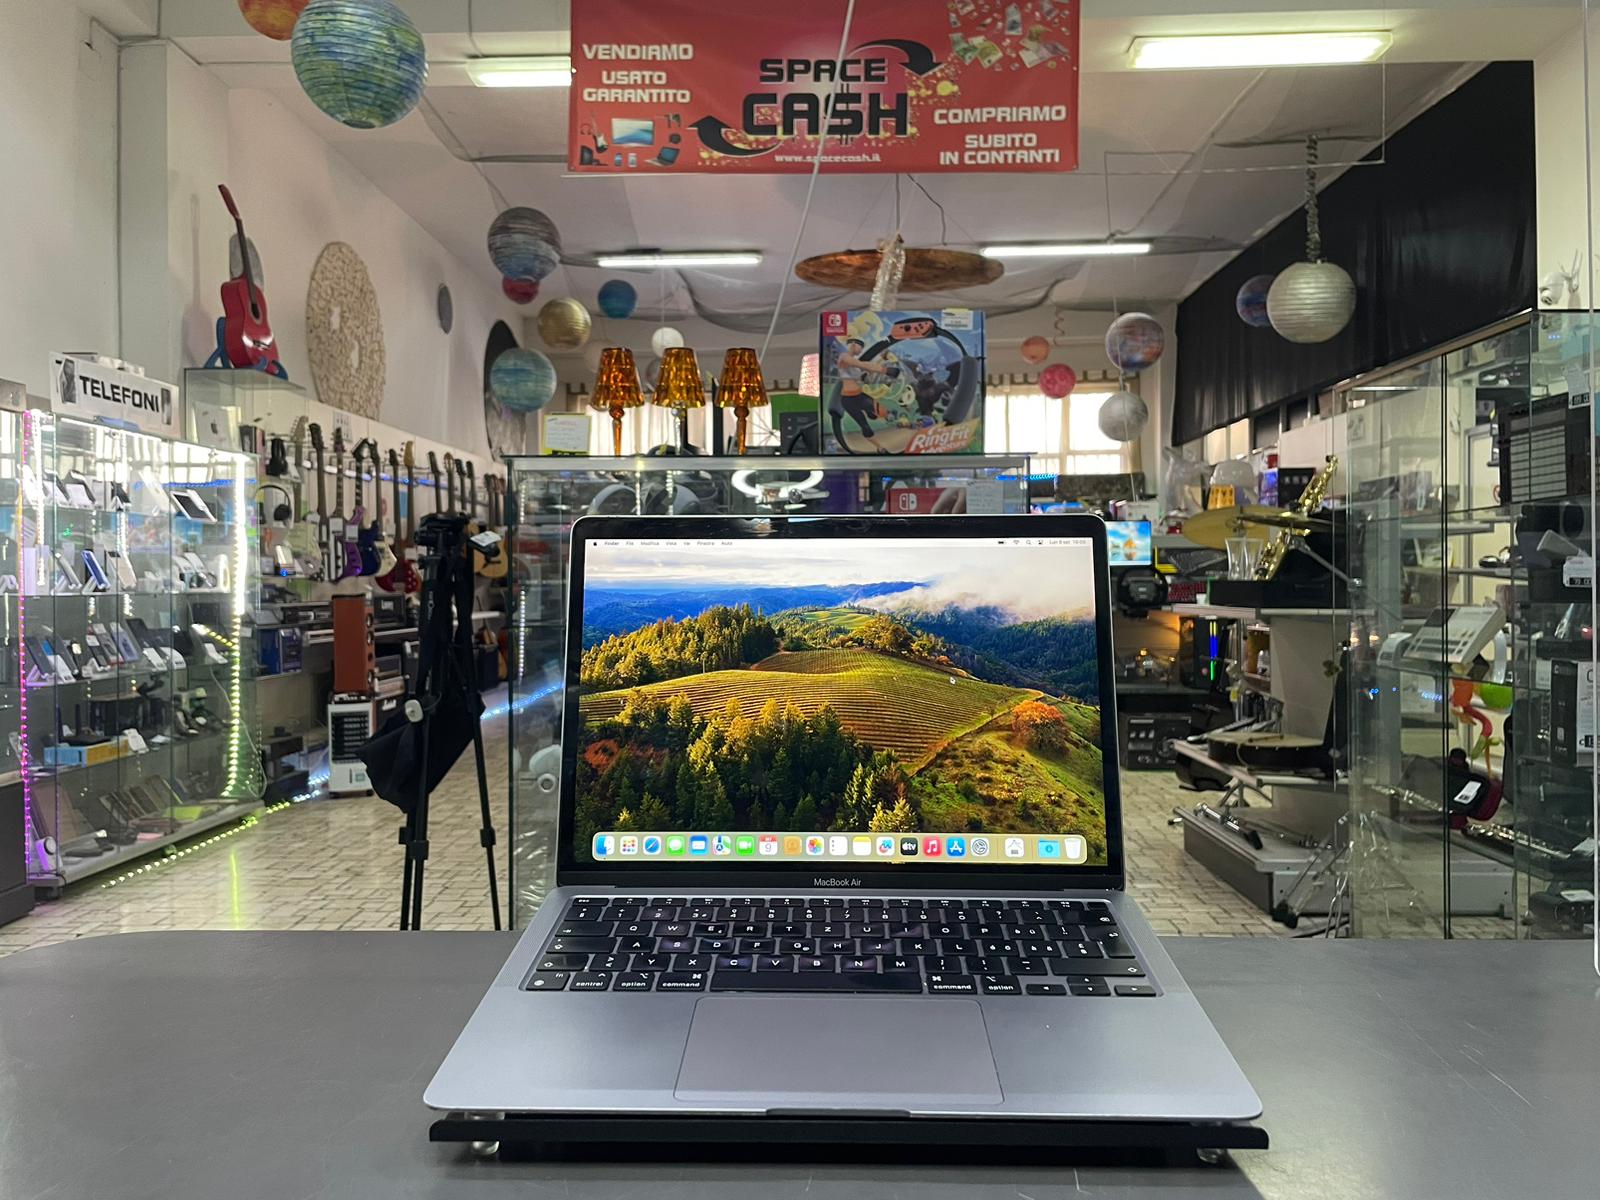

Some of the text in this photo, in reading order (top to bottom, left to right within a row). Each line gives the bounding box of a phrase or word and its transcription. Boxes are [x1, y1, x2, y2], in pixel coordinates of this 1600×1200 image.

[582, 43, 693, 61] VENDIAMO
[601, 70, 667, 85] USATO
[759, 58, 886, 82] SPACE
[582, 87, 691, 103] GARANTITO
[933, 105, 1067, 124] COMPRIAMO
[964, 132, 1038, 148] SUBITO
[940, 149, 1060, 165] IN CONTANTI
[79, 375, 159, 413] TELEFONI
[909, 430, 950, 452] Ring
[765, 843, 771, 852] 9
[814, 878, 861, 886] MacBook Air
